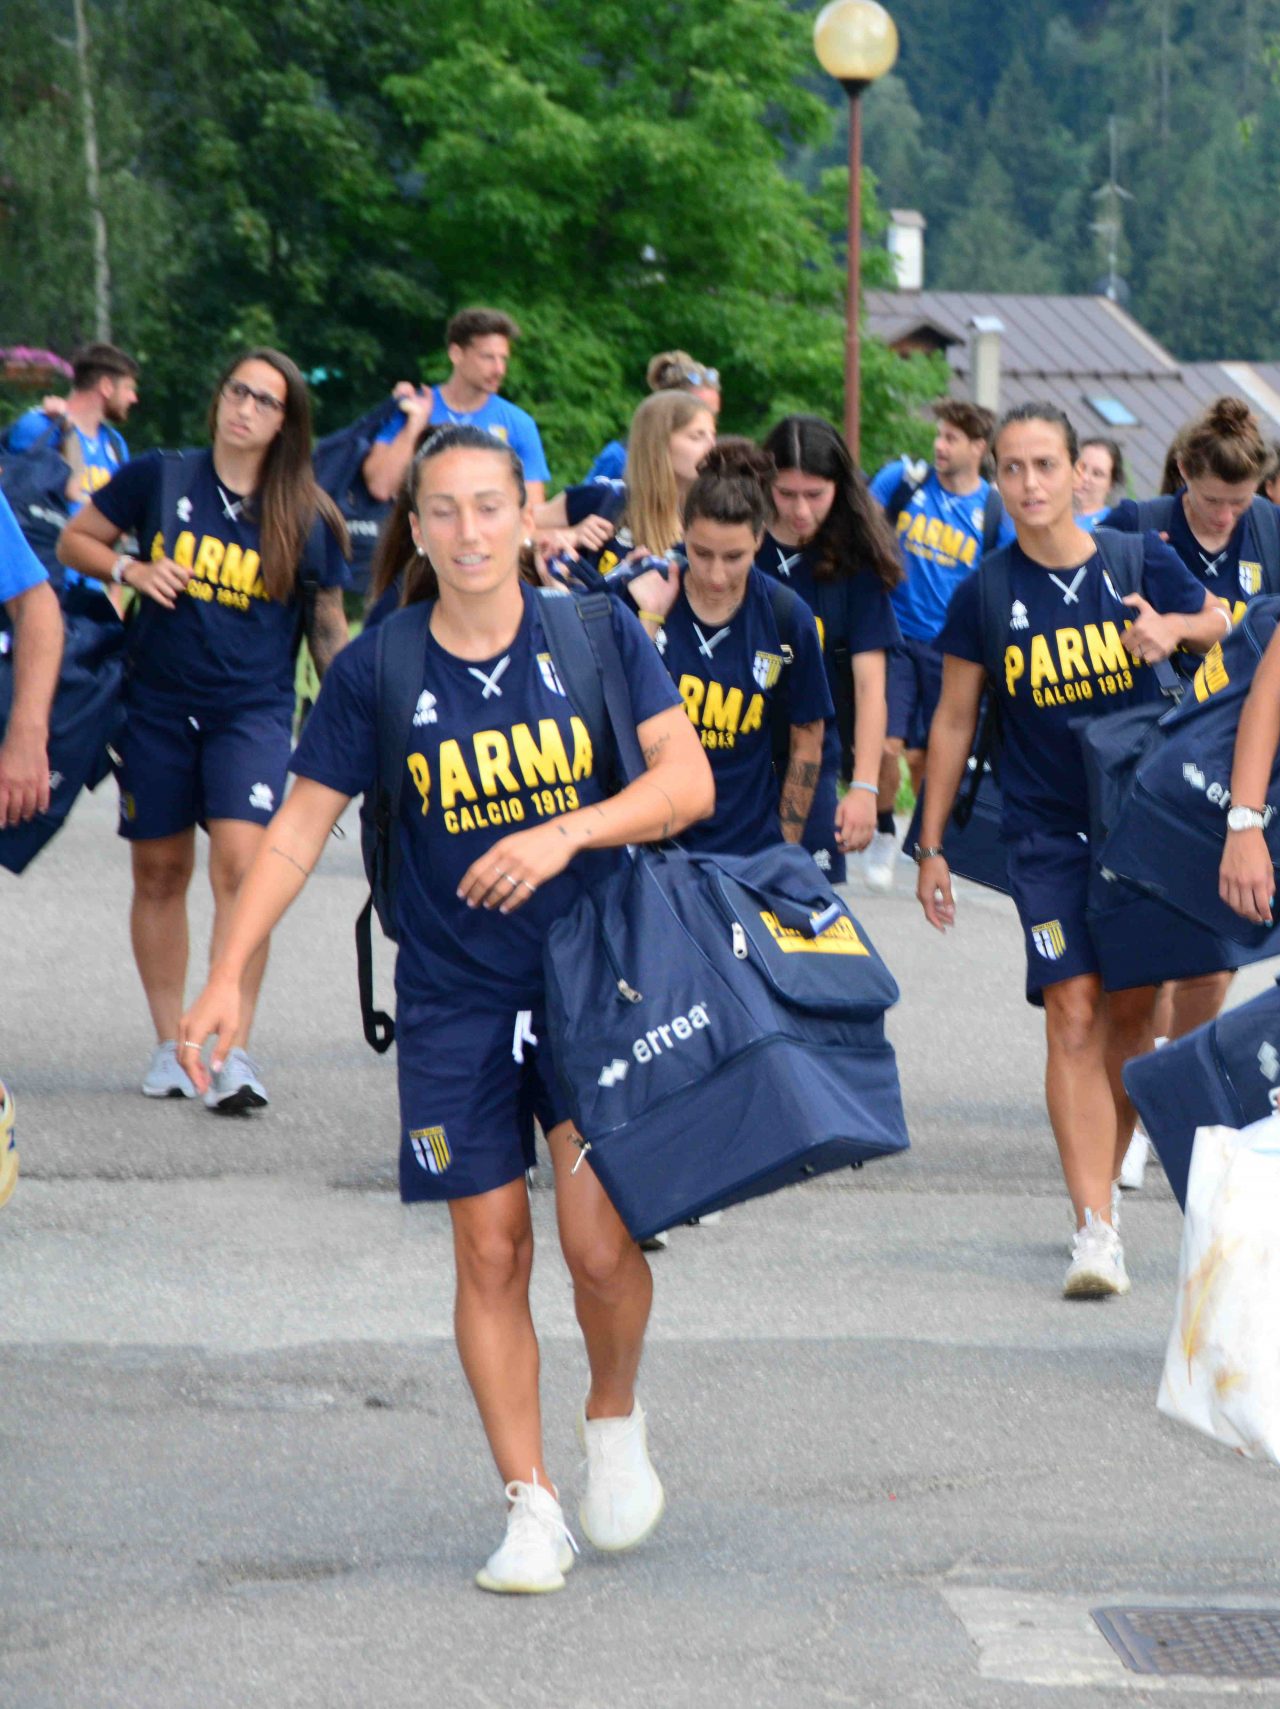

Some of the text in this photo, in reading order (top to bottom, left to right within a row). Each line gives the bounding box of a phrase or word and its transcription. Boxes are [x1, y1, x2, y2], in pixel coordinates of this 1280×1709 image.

[895, 510, 978, 568] PARMA
[677, 673, 765, 735] RMA
[1032, 669, 1134, 709] CALCIO 1913
[406, 716, 594, 817] PARMA
[443, 785, 580, 834] CALCIO 1913
